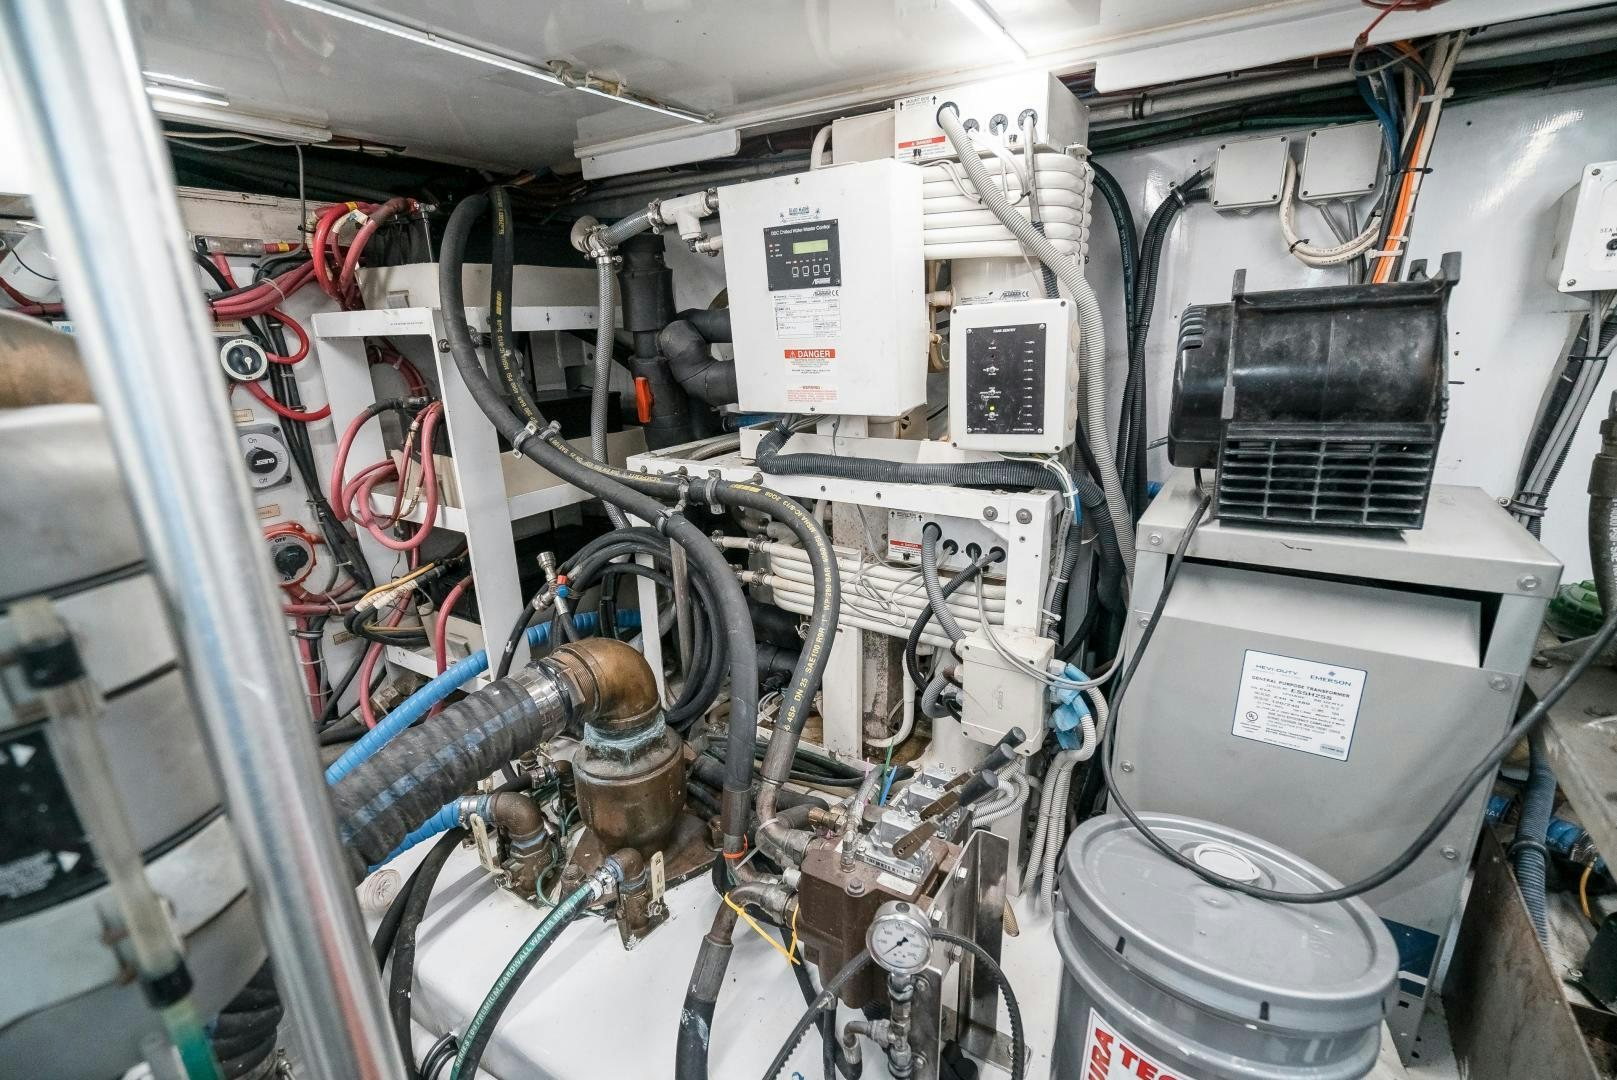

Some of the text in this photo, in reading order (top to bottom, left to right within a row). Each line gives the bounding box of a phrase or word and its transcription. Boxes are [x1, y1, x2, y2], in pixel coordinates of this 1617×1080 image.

[797, 350, 830, 358] DANGER
[786, 706, 796, 722] 4SP
[794, 689, 804, 701] DN
[800, 678, 808, 688] 25
[805, 644, 821, 673] SAE100
[1251, 675, 1349, 698] GENERAL PURPOSE TRANSFORMER
[1309, 674, 1351, 687] EMERSON
[455, 1040, 470, 1068] SERIES
[475, 986, 501, 1028] PREMIUM
[499, 945, 532, 990] HARDWALL
[529, 920, 553, 948] WATER
[1120, 1043, 1178, 1080] TE
